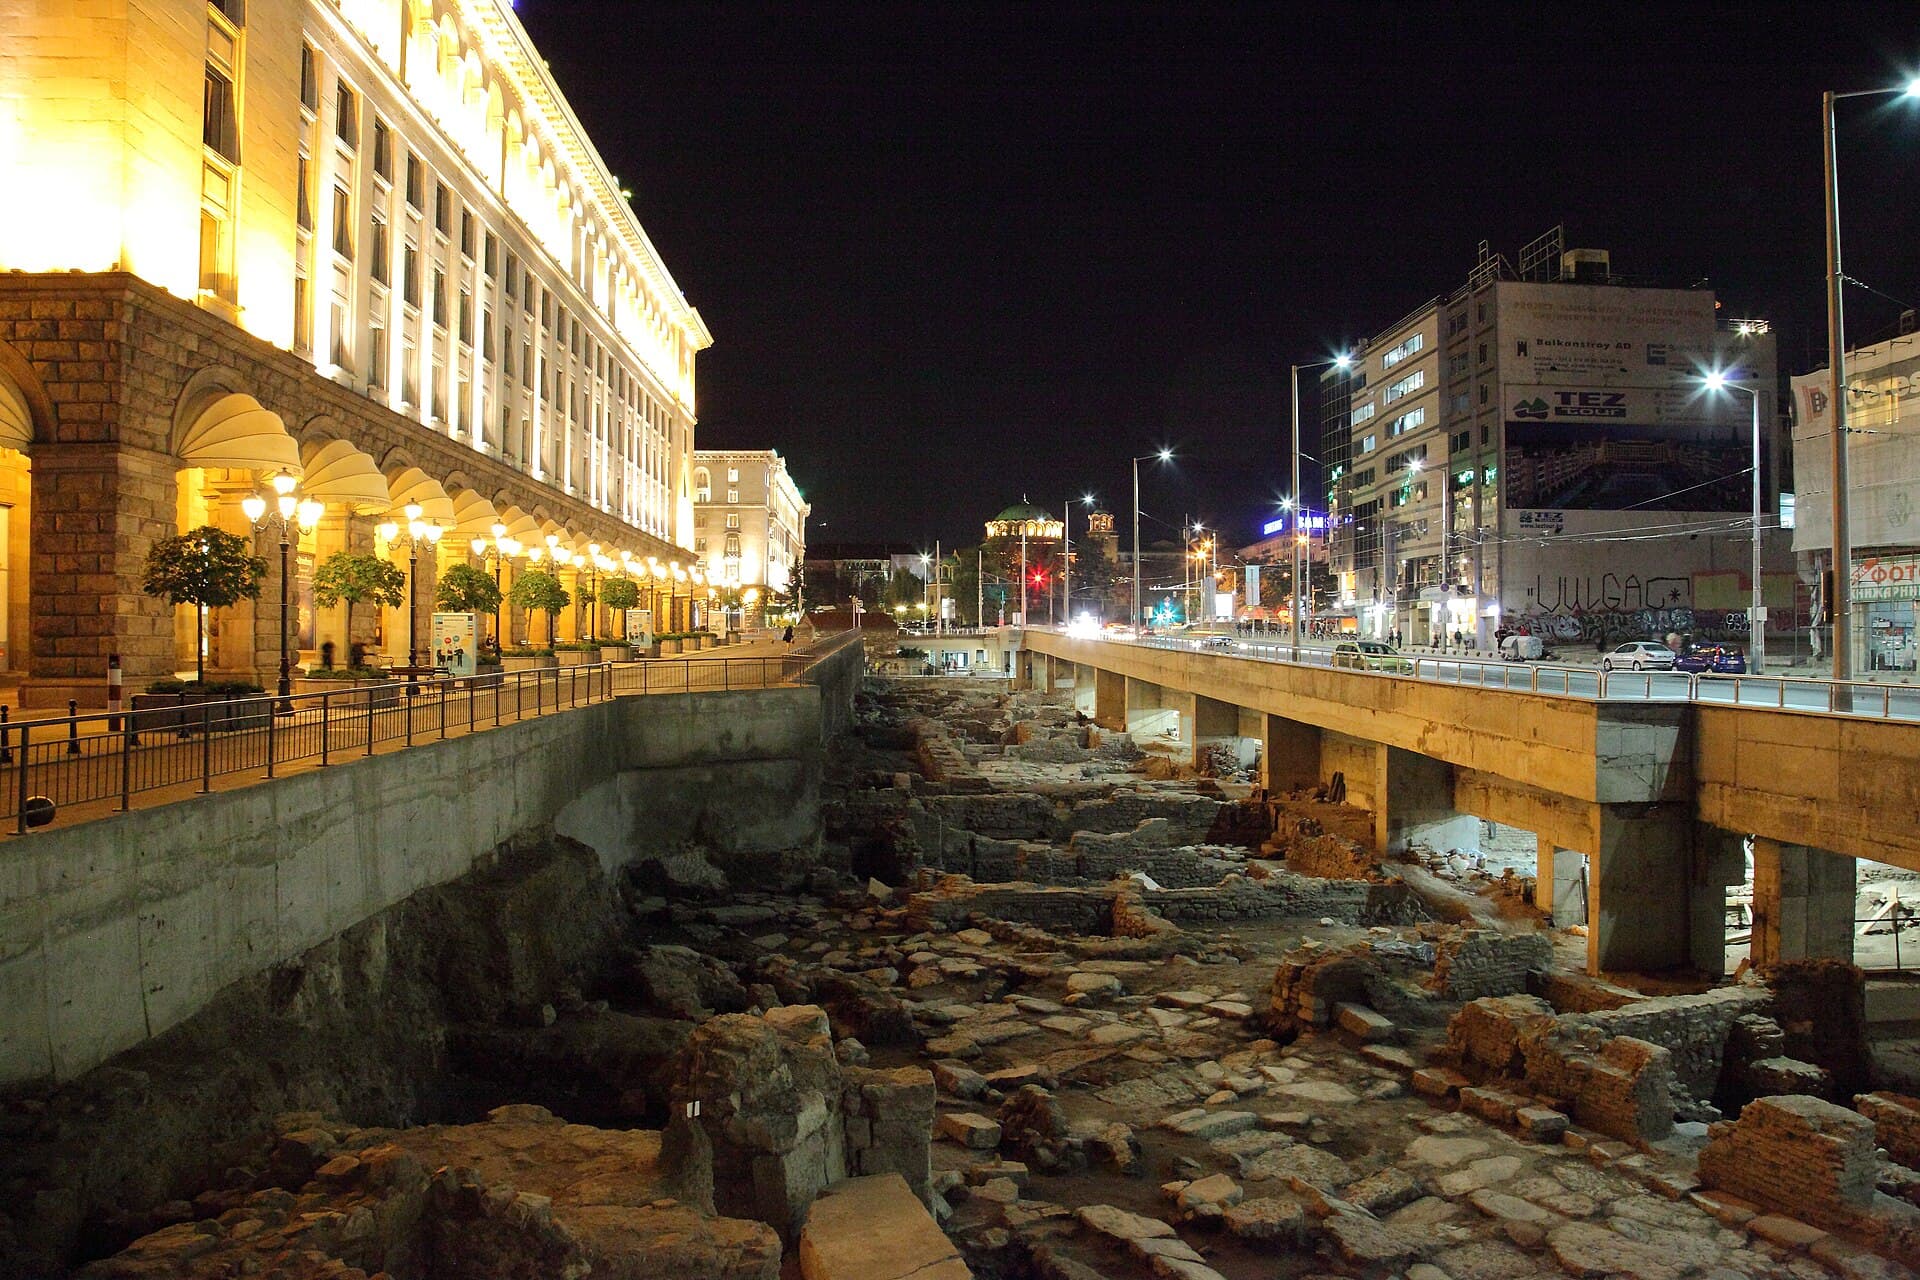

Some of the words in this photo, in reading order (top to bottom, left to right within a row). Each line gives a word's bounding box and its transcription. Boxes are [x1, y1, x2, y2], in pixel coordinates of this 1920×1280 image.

[1536, 338, 1610, 350] Balkanstroy
[1615, 342, 1632, 350] AD
[1554, 391, 1626, 407] TEZ
[1561, 408, 1621, 416] tour
[1871, 564, 1920, 584] ФОТ
[1851, 585, 1920, 600] КНИЖАРНИ
